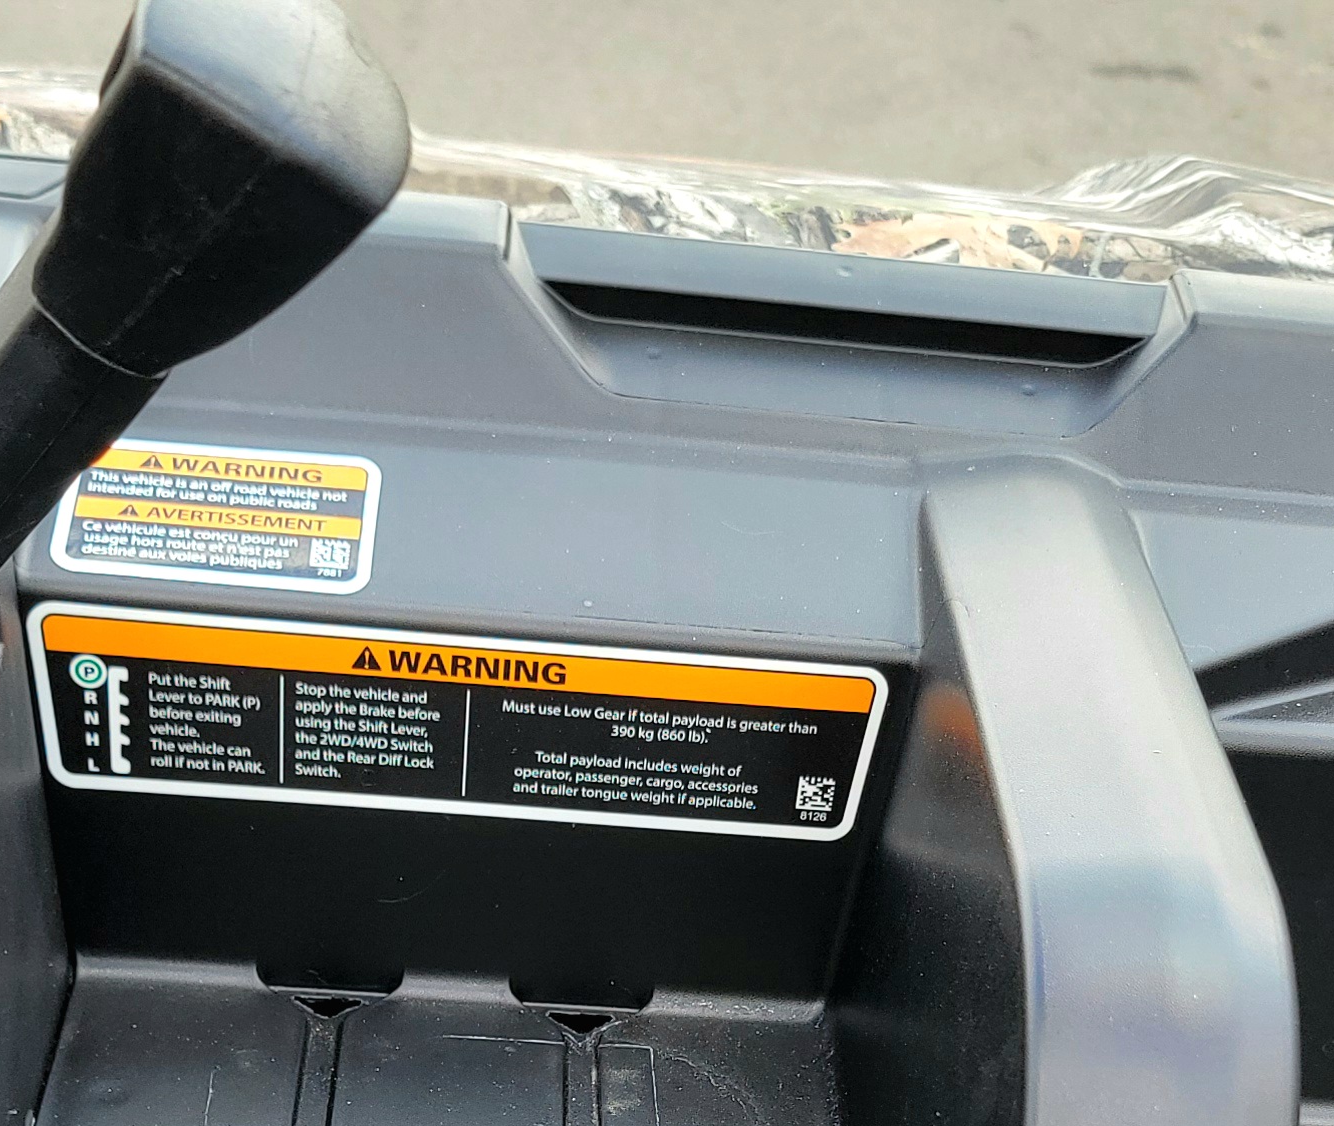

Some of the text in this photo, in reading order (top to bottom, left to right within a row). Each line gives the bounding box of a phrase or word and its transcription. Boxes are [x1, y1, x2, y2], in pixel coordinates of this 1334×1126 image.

[172, 457, 323, 483] WARNING
[90, 470, 348, 502] This vehicle is an off road vehicle not
[155, 487, 177, 499] for
[178, 490, 205, 501] use
[207, 493, 227, 503] on
[229, 493, 276, 507] public
[277, 498, 317, 511] roads
[146, 506, 328, 532] AVERTISSEMENT
[82, 520, 102, 532] Ce
[168, 527, 192, 538] est
[193, 530, 238, 544] conçu
[240, 533, 277, 547] pour
[279, 536, 298, 548] un
[84, 533, 128, 546] usage
[130, 535, 163, 548] hors
[166, 539, 206, 551] route
[208, 542, 224, 553] et
[264, 547, 289, 559] pas
[138, 547, 165, 559] aux
[208, 555, 283, 570] publiques
[317, 568, 343, 578] 7881
[84, 666, 95, 678] P
[388, 649, 567, 685] WARNING
[148, 671, 231, 691] Put the Shift
[83, 690, 98, 705] R
[148, 688, 261, 711] Lever to PARK (P)
[295, 681, 428, 704] Stop the vehicle and
[84, 710, 100, 726] N
[148, 705, 242, 727] before exiting
[295, 700, 441, 722] apply the Brake before
[502, 699, 818, 735] Must use Low Gear if total payload is greater than
[85, 731, 100, 746] H
[149, 722, 200, 738] vehicle.
[295, 716, 429, 739] using the Shift Lever,
[610, 725, 636, 739] 390
[638, 726, 654, 742] kg
[657, 727, 686, 743] (860
[149, 738, 252, 758] The vehicle can
[295, 731, 434, 753] the 2WD/4WD Switch
[87, 757, 100, 773] L
[150, 754, 266, 775] roll if not in PARK.
[295, 748, 434, 770] and the Rear Diff Lock
[534, 750, 743, 778] Total payload includes weight of
[294, 762, 342, 779] Switch.
[513, 766, 759, 795] operator, passenger, cargo, accessories
[512, 781, 757, 810] and trailer tongue weight if applicable.
[799, 811, 827, 822] 8126
